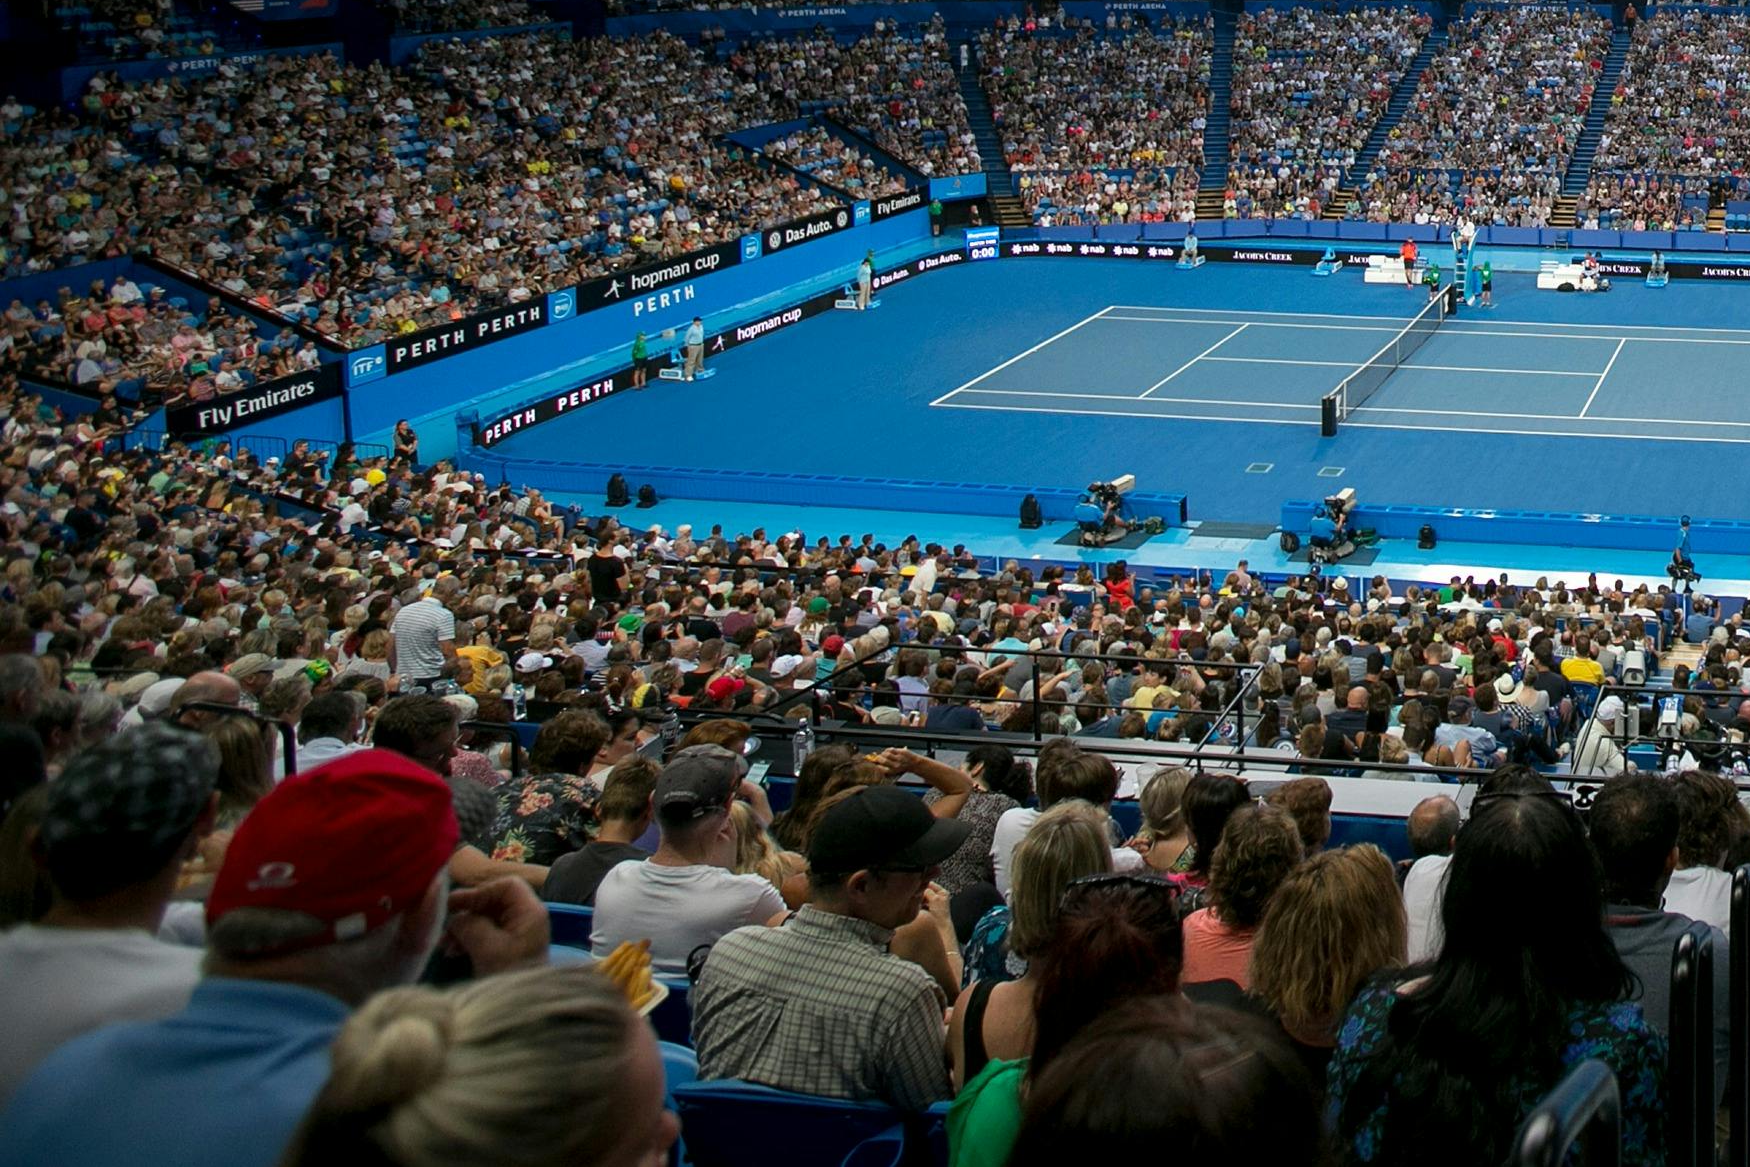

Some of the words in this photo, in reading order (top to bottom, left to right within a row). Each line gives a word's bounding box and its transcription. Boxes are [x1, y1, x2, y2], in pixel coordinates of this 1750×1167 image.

[788, 9, 817, 17] PERTH
[818, 8, 846, 16] ARENA
[1113, 2, 1139, 10] PERTH
[181, 58, 222, 70] PERTH
[877, 200, 890, 215] Fly
[890, 193, 920, 211] Emirates
[786, 228, 805, 243] Das
[806, 220, 833, 236] Auto.
[972, 246, 995, 259] 0:00
[1022, 243, 1040, 253] nab
[1056, 243, 1072, 253] nab
[1090, 244, 1106, 254] nab
[1123, 246, 1139, 255] nab
[1158, 246, 1174, 256] nab
[926, 258, 938, 268] Das
[939, 254, 962, 264] Auto.
[1233, 250, 1264, 260] JACOB'S
[1264, 252, 1292, 262] CREEK
[631, 262, 690, 290] hopman
[694, 252, 720, 271] cup
[1612, 264, 1642, 274] CREEK
[1702, 266, 1736, 276] JACOB'S
[880, 274, 893, 285] Das
[892, 269, 910, 280] Auto.
[634, 284, 695, 316] PERTH
[736, 315, 781, 342] hopman
[782, 308, 802, 324] cup
[396, 329, 464, 362] PERTH
[478, 306, 540, 336] PERTH
[353, 360, 373, 378] ITF
[199, 406, 232, 429] Fly
[235, 381, 316, 418] Emirates
[484, 408, 536, 444] PERTH
[557, 378, 614, 412] PERTH
